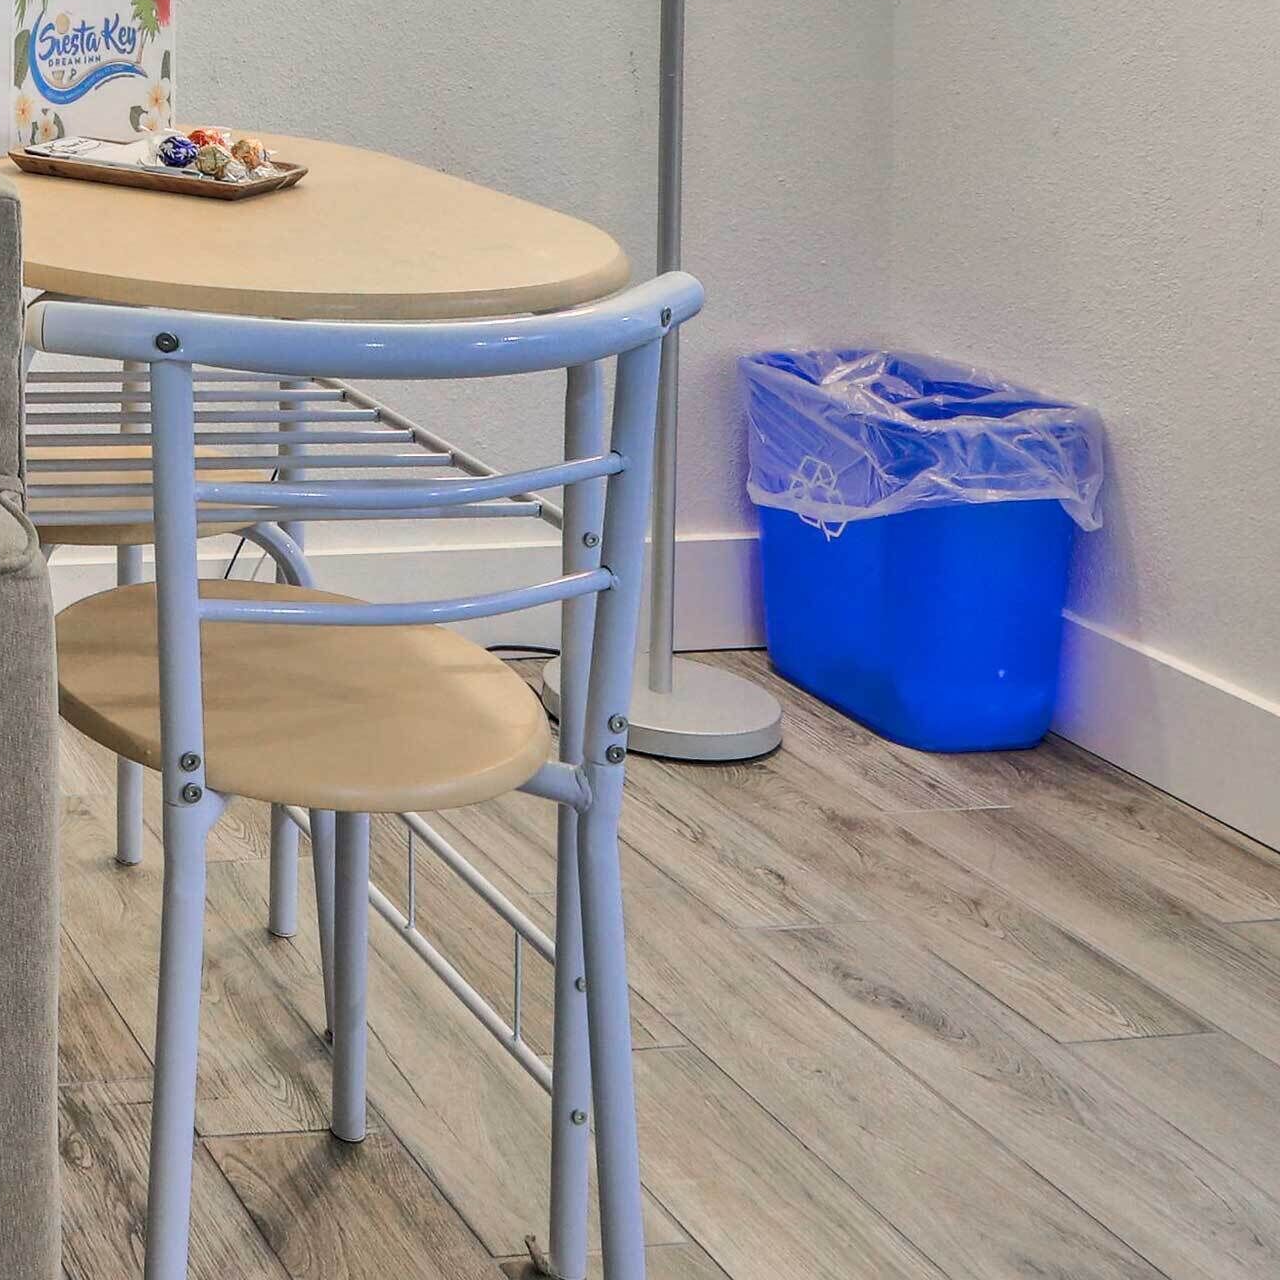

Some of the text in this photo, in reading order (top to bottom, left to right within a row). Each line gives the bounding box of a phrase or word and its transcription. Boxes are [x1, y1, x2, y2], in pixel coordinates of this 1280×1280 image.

[38, 12, 137, 61] Siesta Key
[47, 55, 102, 68] DREAM INN
